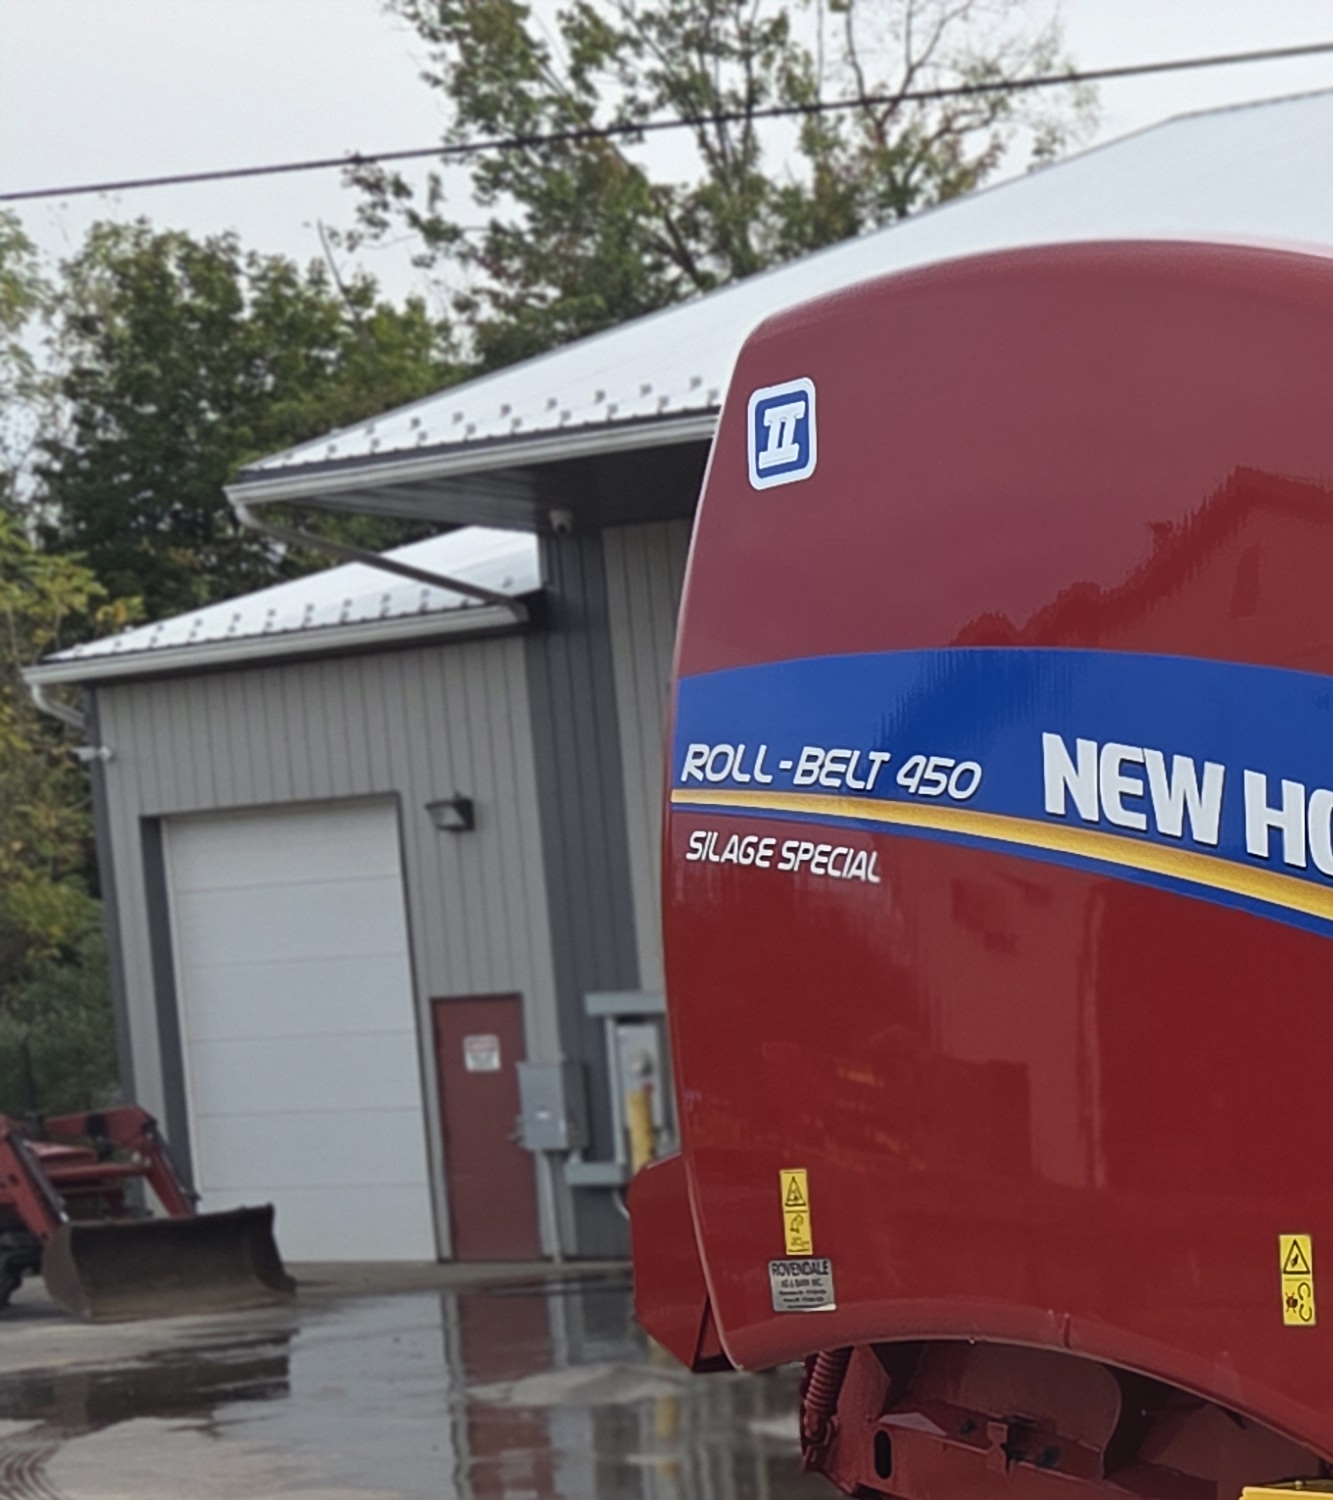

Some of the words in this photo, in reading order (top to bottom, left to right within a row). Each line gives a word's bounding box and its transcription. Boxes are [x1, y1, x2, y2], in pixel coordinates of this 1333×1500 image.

[680, 743, 891, 791] ROLL-BELT
[895, 755, 982, 800] 450
[1042, 731, 1226, 846] NEW
[685, 830, 777, 868] SILAGE
[777, 840, 881, 884] SPECIAL
